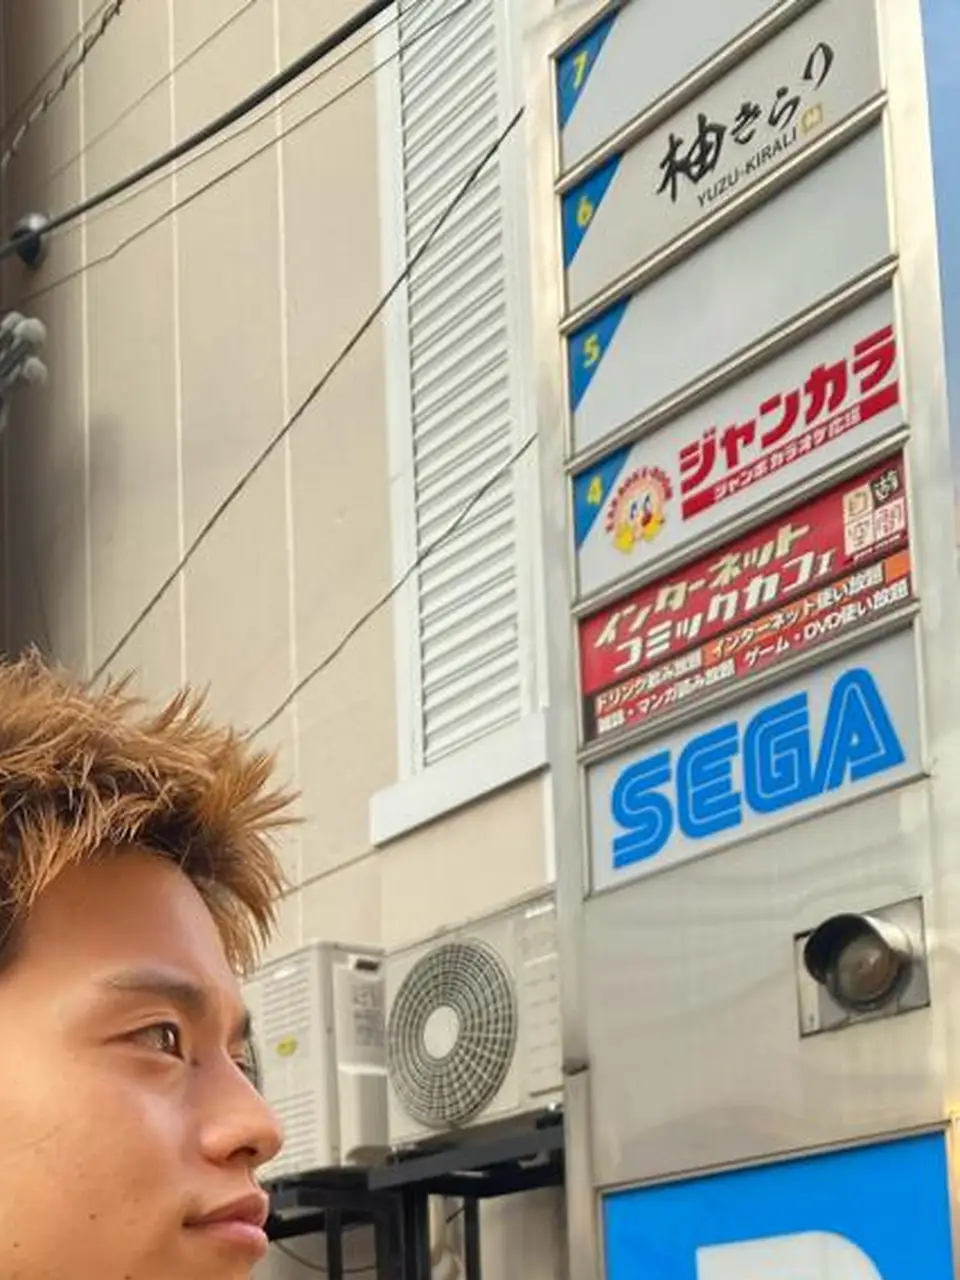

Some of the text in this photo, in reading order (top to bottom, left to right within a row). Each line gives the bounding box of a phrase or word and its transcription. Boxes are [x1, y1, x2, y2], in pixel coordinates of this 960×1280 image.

[577, 196, 593, 228] 6
[696, 127, 798, 207] YUZU-KIRALI
[583, 334, 600, 368] 5
[679, 324, 897, 495] ジャンカラ
[587, 476, 602, 505] 4
[594, 524, 810, 648] インターネット
[614, 548, 836, 673] コミックカフェ
[612, 667, 906, 869] SEGA
